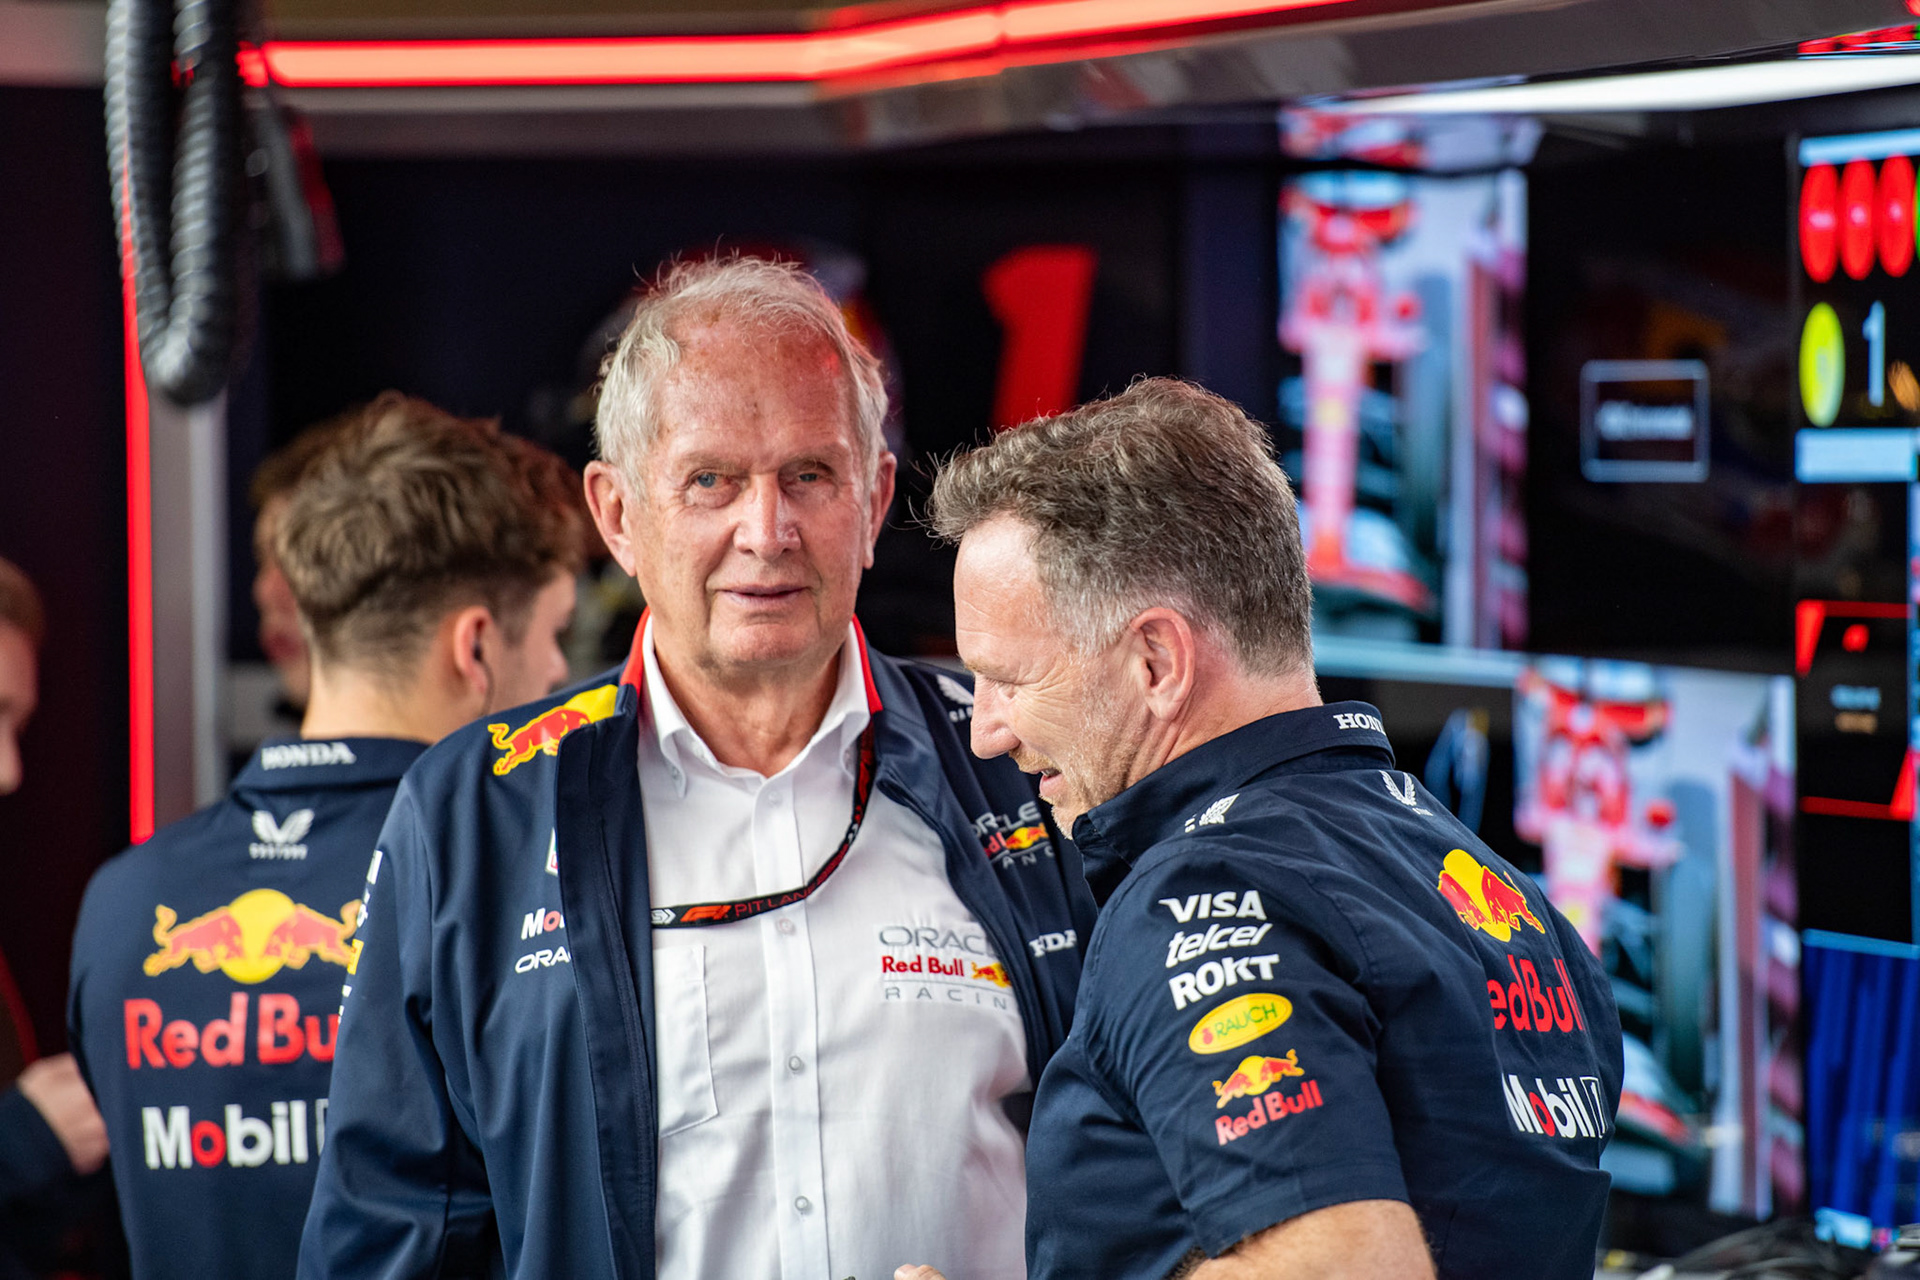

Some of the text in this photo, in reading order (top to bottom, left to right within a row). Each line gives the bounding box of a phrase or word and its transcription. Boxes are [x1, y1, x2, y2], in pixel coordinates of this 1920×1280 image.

[1862, 300, 1886, 407] 1
[261, 742, 357, 771] HONDA
[734, 899, 766, 918] PIT
[1158, 890, 1268, 924] VISA
[515, 946, 572, 974] ORA
[882, 954, 965, 977] Red Bull
[1165, 922, 1274, 969] telcel
[1168, 953, 1280, 1011] ROKT
[1519, 958, 1585, 1033] Bull
[124, 992, 249, 1069] Red
[1214, 1001, 1278, 1039] RAUCH
[1215, 1079, 1323, 1146] Red Bull
[1502, 1073, 1596, 1139] Mobil
[142, 1100, 309, 1170] Mobil
